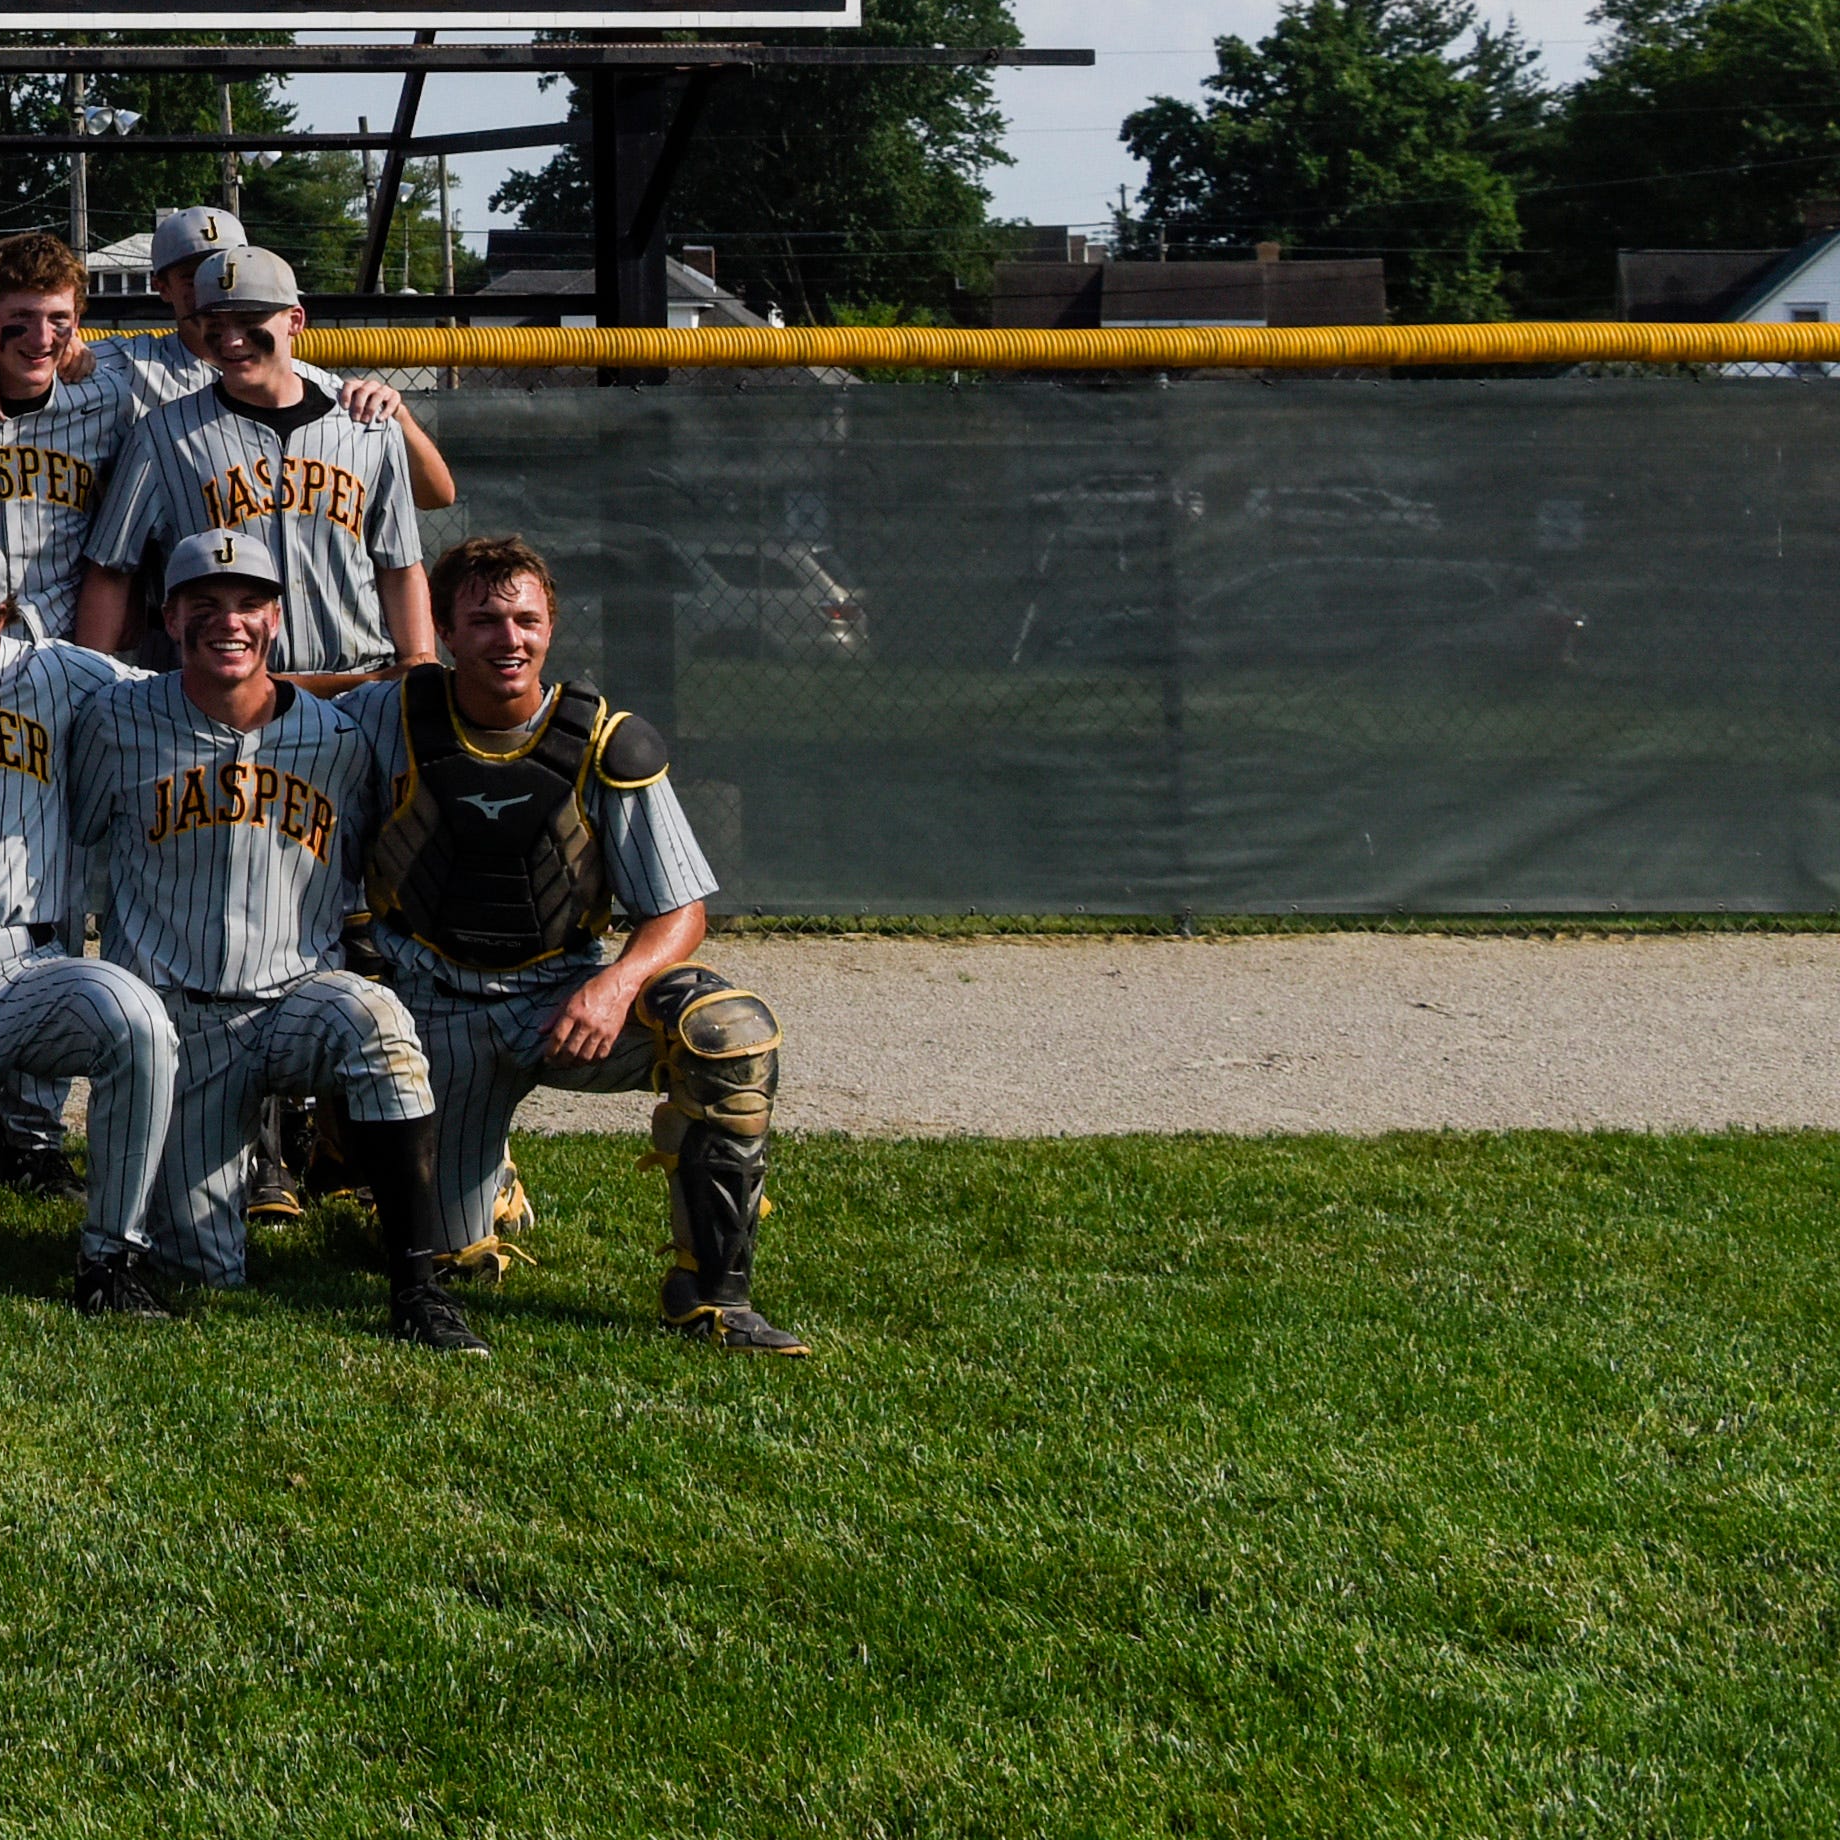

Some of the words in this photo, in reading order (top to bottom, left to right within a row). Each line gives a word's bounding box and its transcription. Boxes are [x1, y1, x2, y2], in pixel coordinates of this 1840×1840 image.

[200, 215, 219, 242] J
[219, 261, 237, 291] J
[213, 536, 237, 566] J
[148, 762, 333, 865] JASPER
